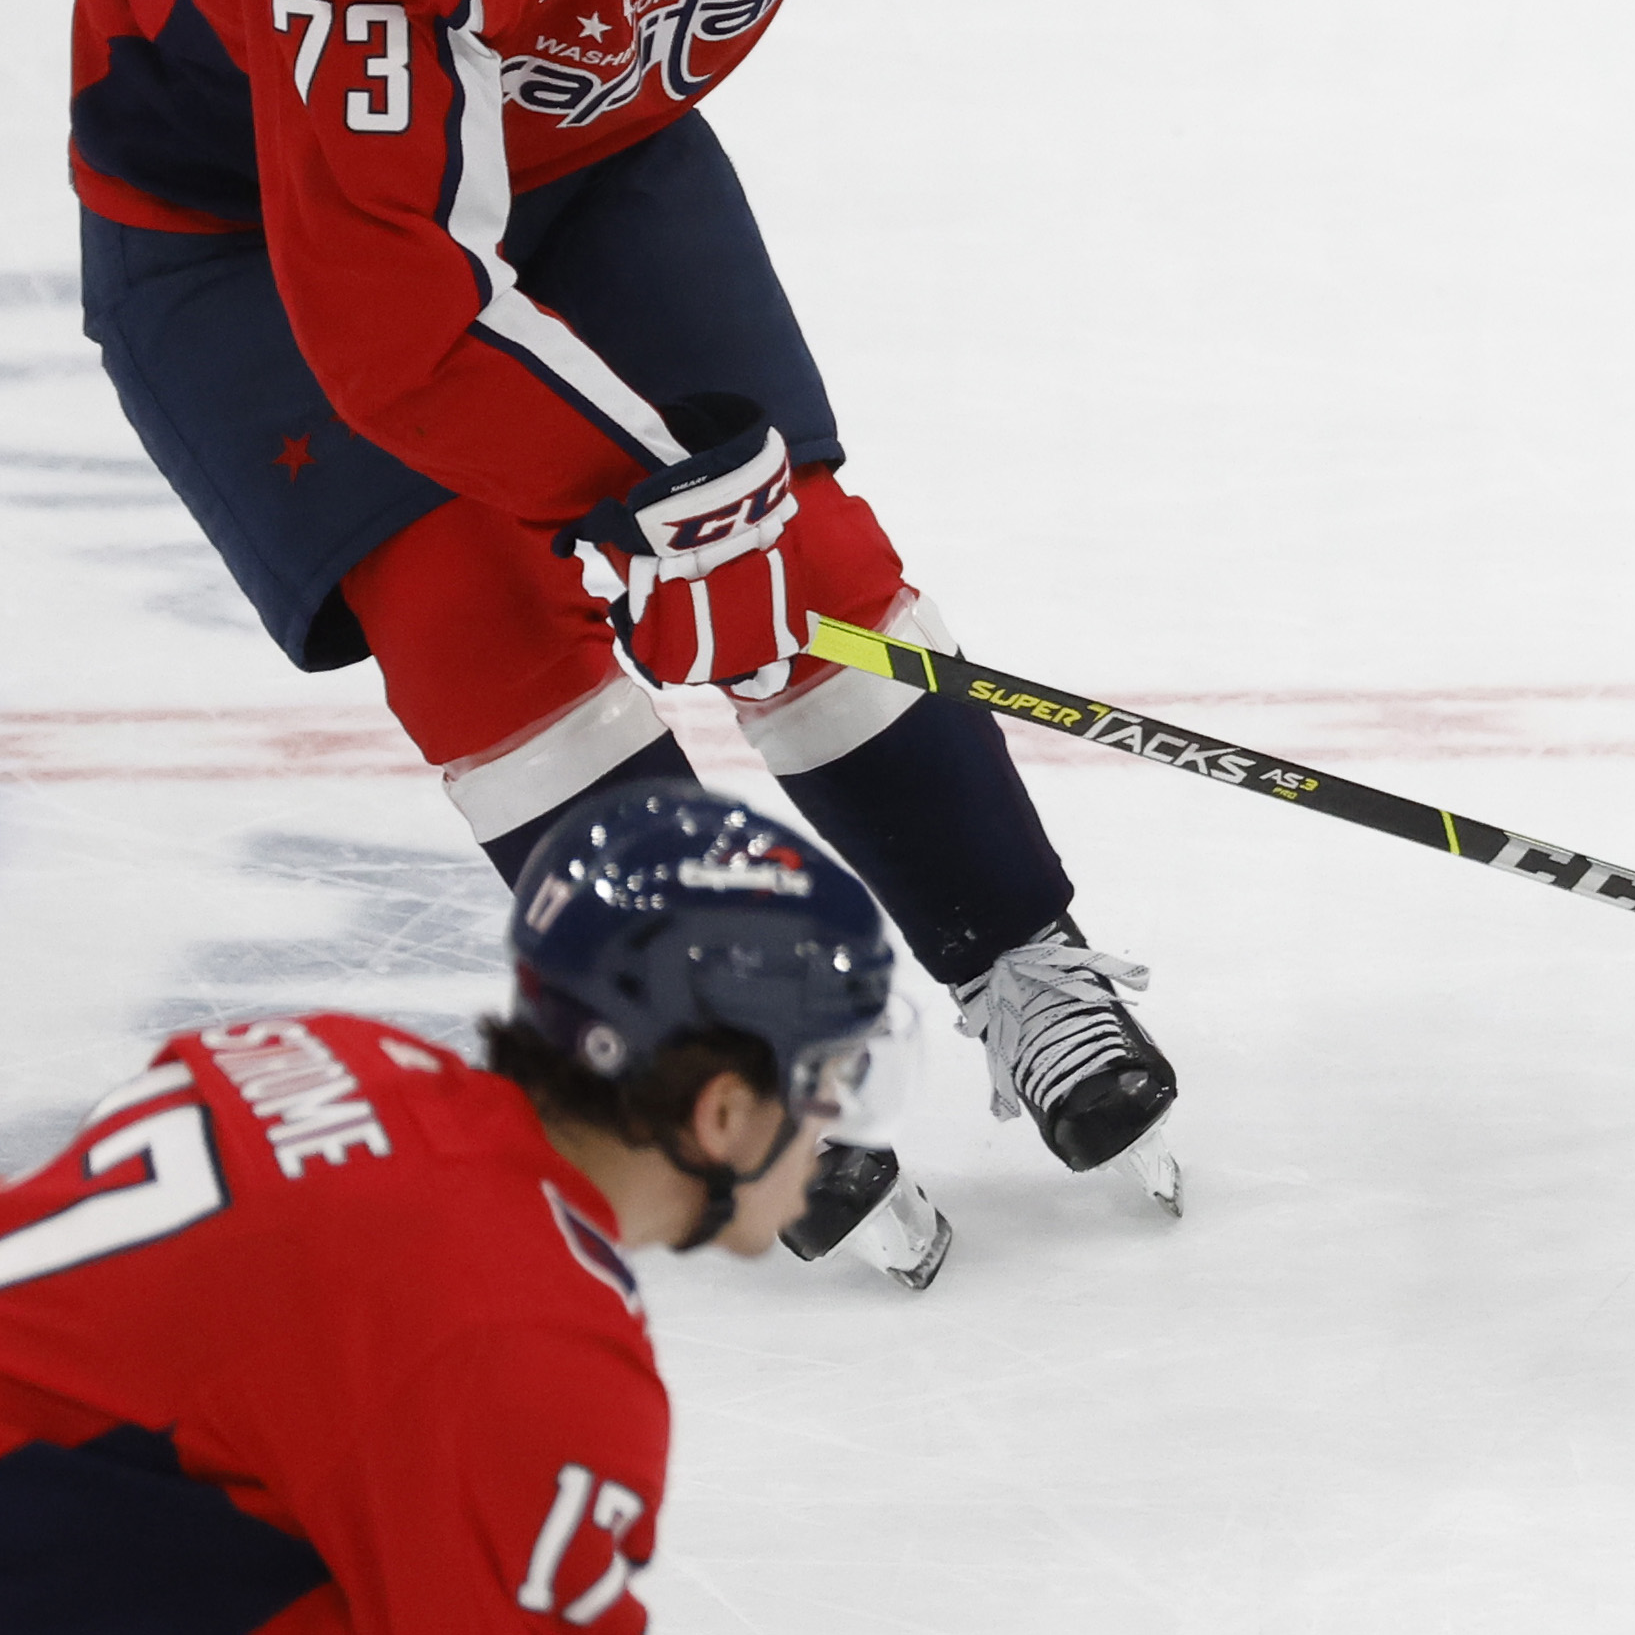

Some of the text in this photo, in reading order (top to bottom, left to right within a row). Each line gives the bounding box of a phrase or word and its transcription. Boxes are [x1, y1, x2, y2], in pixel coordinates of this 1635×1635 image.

[968, 680, 1083, 728] SUPER
[1082, 703, 1257, 785] TACKS
[200, 1021, 392, 1180] STROME
[517, 1463, 645, 1626] 17
